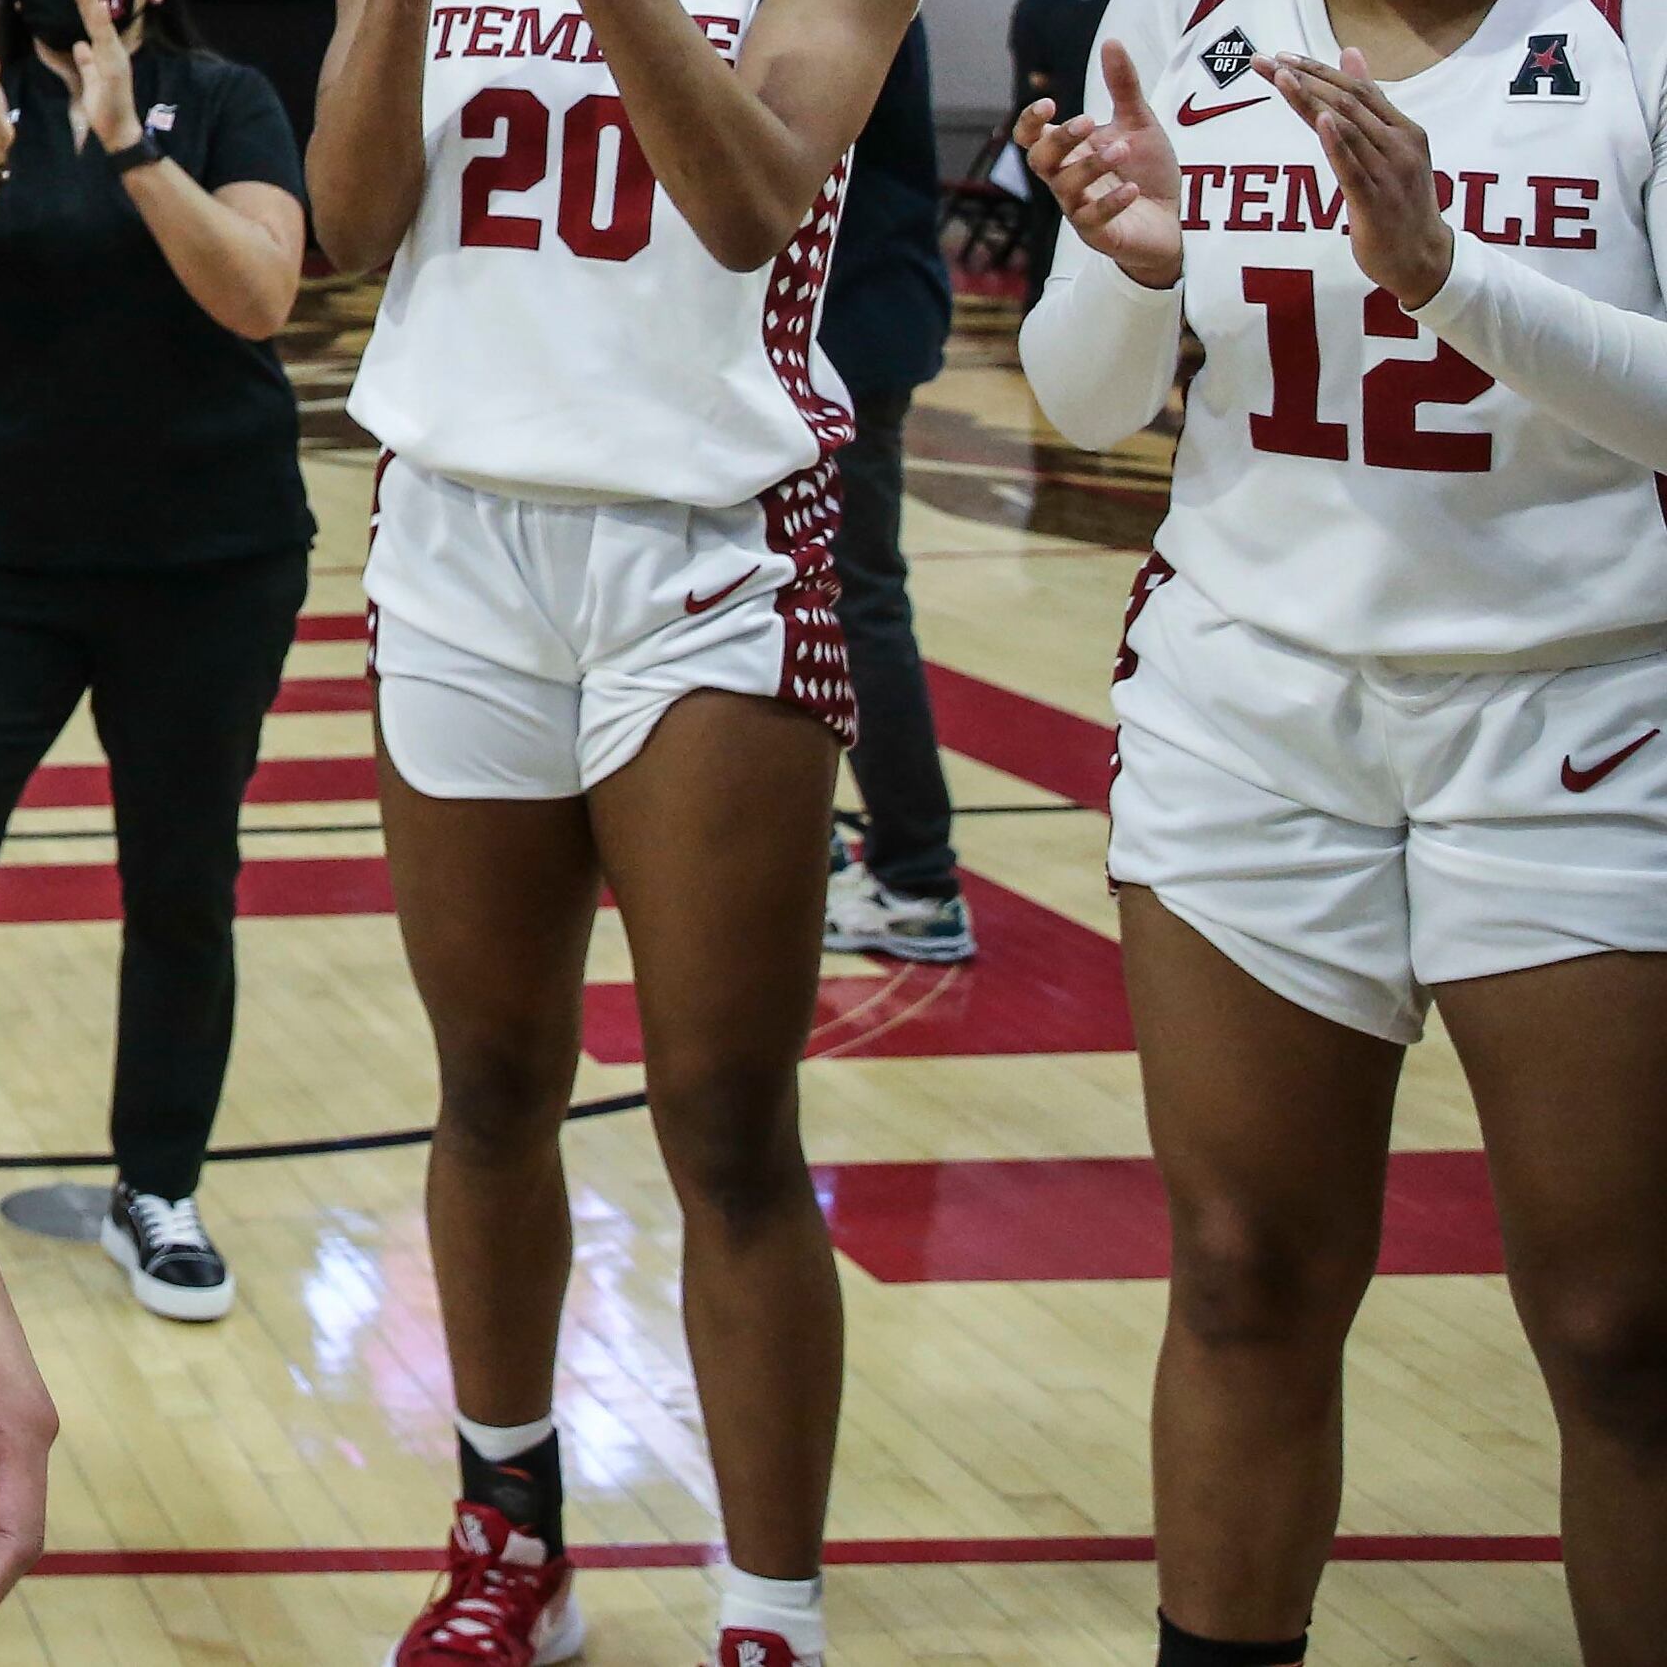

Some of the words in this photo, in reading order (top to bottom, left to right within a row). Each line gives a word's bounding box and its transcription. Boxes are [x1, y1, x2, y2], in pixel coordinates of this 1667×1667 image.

[432, 6, 740, 69] TEME
[1214, 37, 1245, 56] BLM
[1509, 33, 1582, 97] A
[460, 87, 658, 262] 20
[1241, 265, 1495, 474] 12
